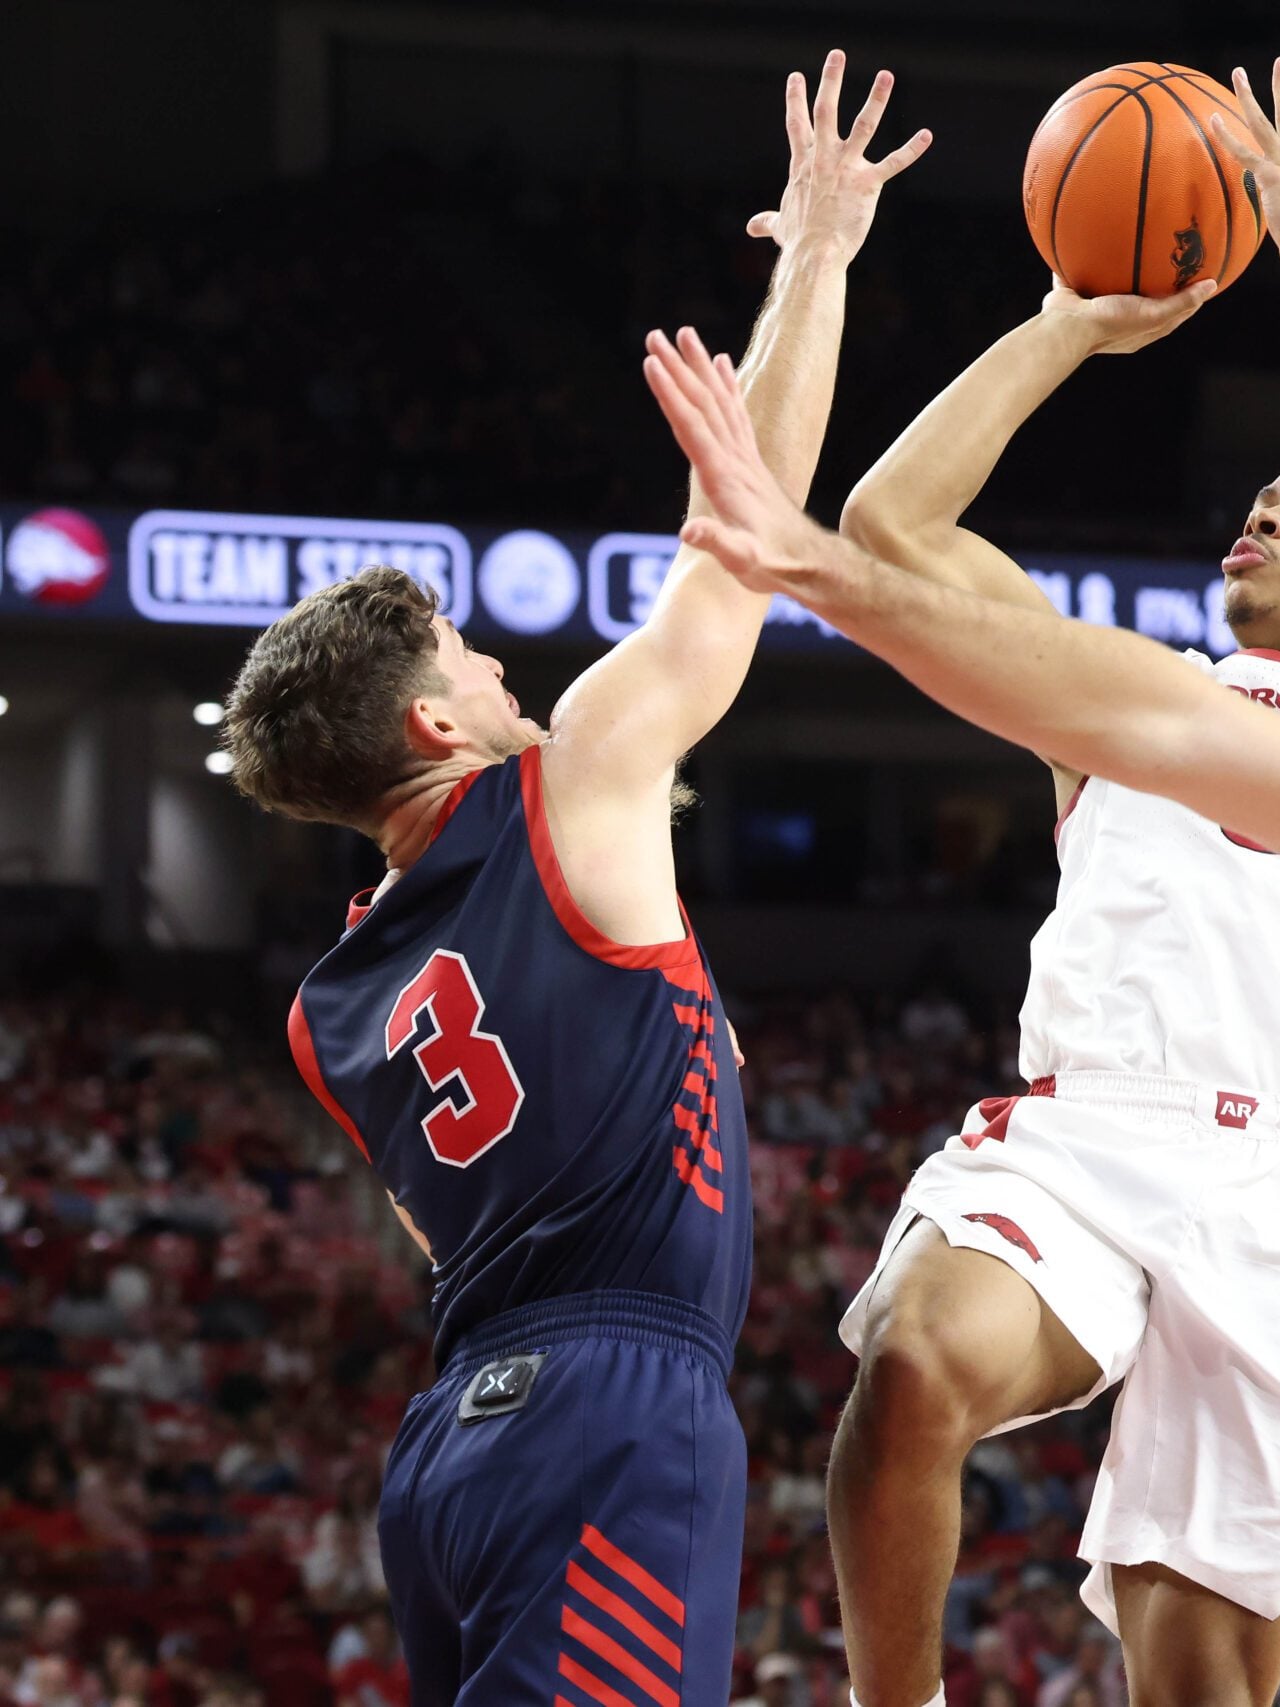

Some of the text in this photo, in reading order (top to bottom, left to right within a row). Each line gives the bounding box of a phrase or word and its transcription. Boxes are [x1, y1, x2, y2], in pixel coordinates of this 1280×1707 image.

[150, 532, 289, 605] TEAM
[385, 948, 525, 1168] 3
[1219, 1100, 1252, 1120] AR
